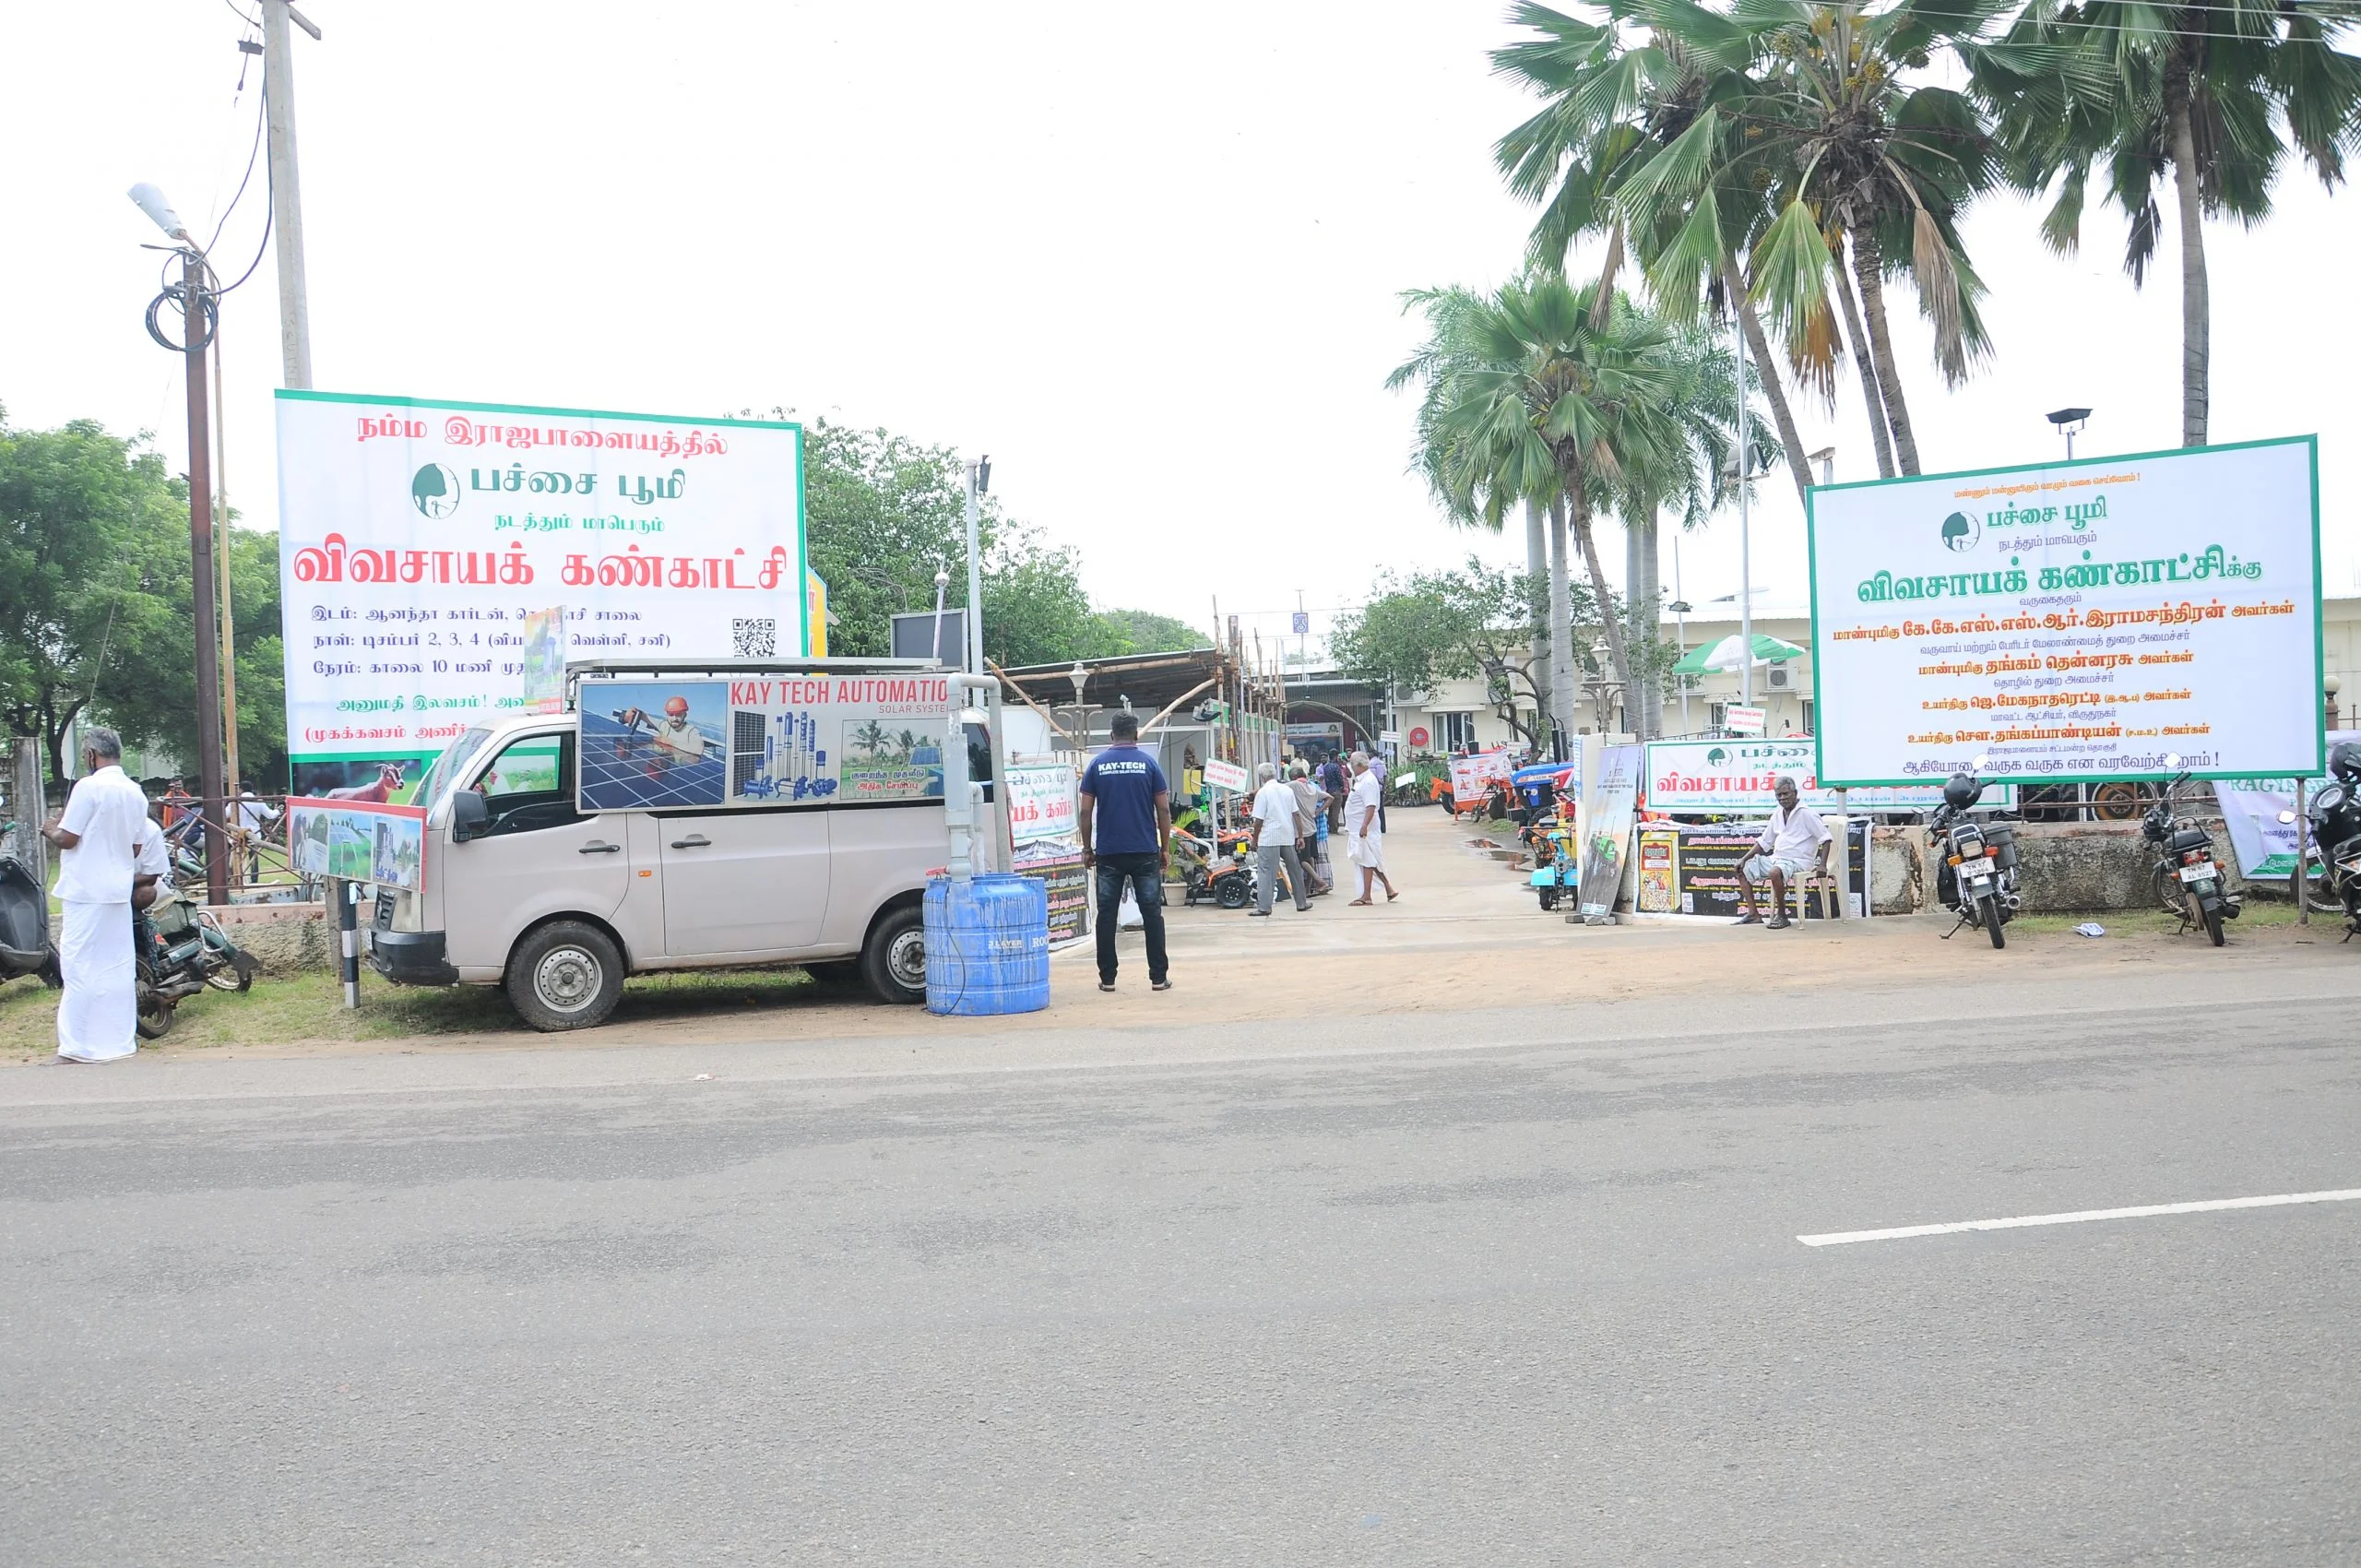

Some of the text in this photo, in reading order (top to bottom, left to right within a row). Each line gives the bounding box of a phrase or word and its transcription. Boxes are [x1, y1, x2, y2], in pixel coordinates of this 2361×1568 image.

[358, 412, 729, 459] நம்ம இராஜபாளையத்தில்
[471, 462, 686, 505] பச்சை பூமி
[1987, 494, 2108, 530] பச்சை பூமி
[494, 512, 666, 535] நடத்தும் மாபெரும்
[1999, 529, 2097, 552] நடத்தும் மாபெரும்
[293, 532, 788, 590] விவசாயக் கண்காட்சி
[1857, 543, 2263, 602] விவசாயக் கண்காட்சிக்கு
[2020, 591, 2082, 607] வருகைதரும்
[311, 605, 358, 622] இடம்:
[365, 608, 439, 623] ஆனந்தா
[595, 611, 643, 621] சாலை
[1833, 625, 1900, 642] மாண்புமிகு
[2231, 599, 2295, 617] அவர்கள்
[362, 633, 419, 647] டிசம்பர்
[469, 633, 480, 646] 4
[1920, 642, 1962, 656] வருவாய்
[1964, 640, 1997, 655] மற்றும்
[2106, 635, 2135, 648] துறை
[2138, 629, 2190, 643] அமைச்சர்
[369, 661, 423, 673] காலை
[433, 659, 447, 672] 10
[456, 659, 492, 673] மணி
[1918, 649, 2194, 676] மாண்புமிகு தங்கம் தென்னரசு அவர்கள்
[1994, 671, 2115, 689] தொழில் துறை அமைச்சர்
[337, 695, 404, 712] அனுமதி
[730, 679, 948, 706] KAY TECH AUTOMATIO
[1922, 697, 1967, 709] உயர்திரு
[2143, 687, 2192, 701] அவர்கள்
[879, 704, 948, 714] SOLAR SYSTE
[1991, 712, 2023, 722] மாவட்ட
[1908, 731, 1952, 743] உயர்திரு
[2162, 722, 2211, 736] அவர்கள்
[1097, 761, 1146, 772] KAY-TECH
[1985, 759, 2022, 774] வருக
[2025, 758, 2063, 773] வருக
[2068, 756, 2094, 769] என
